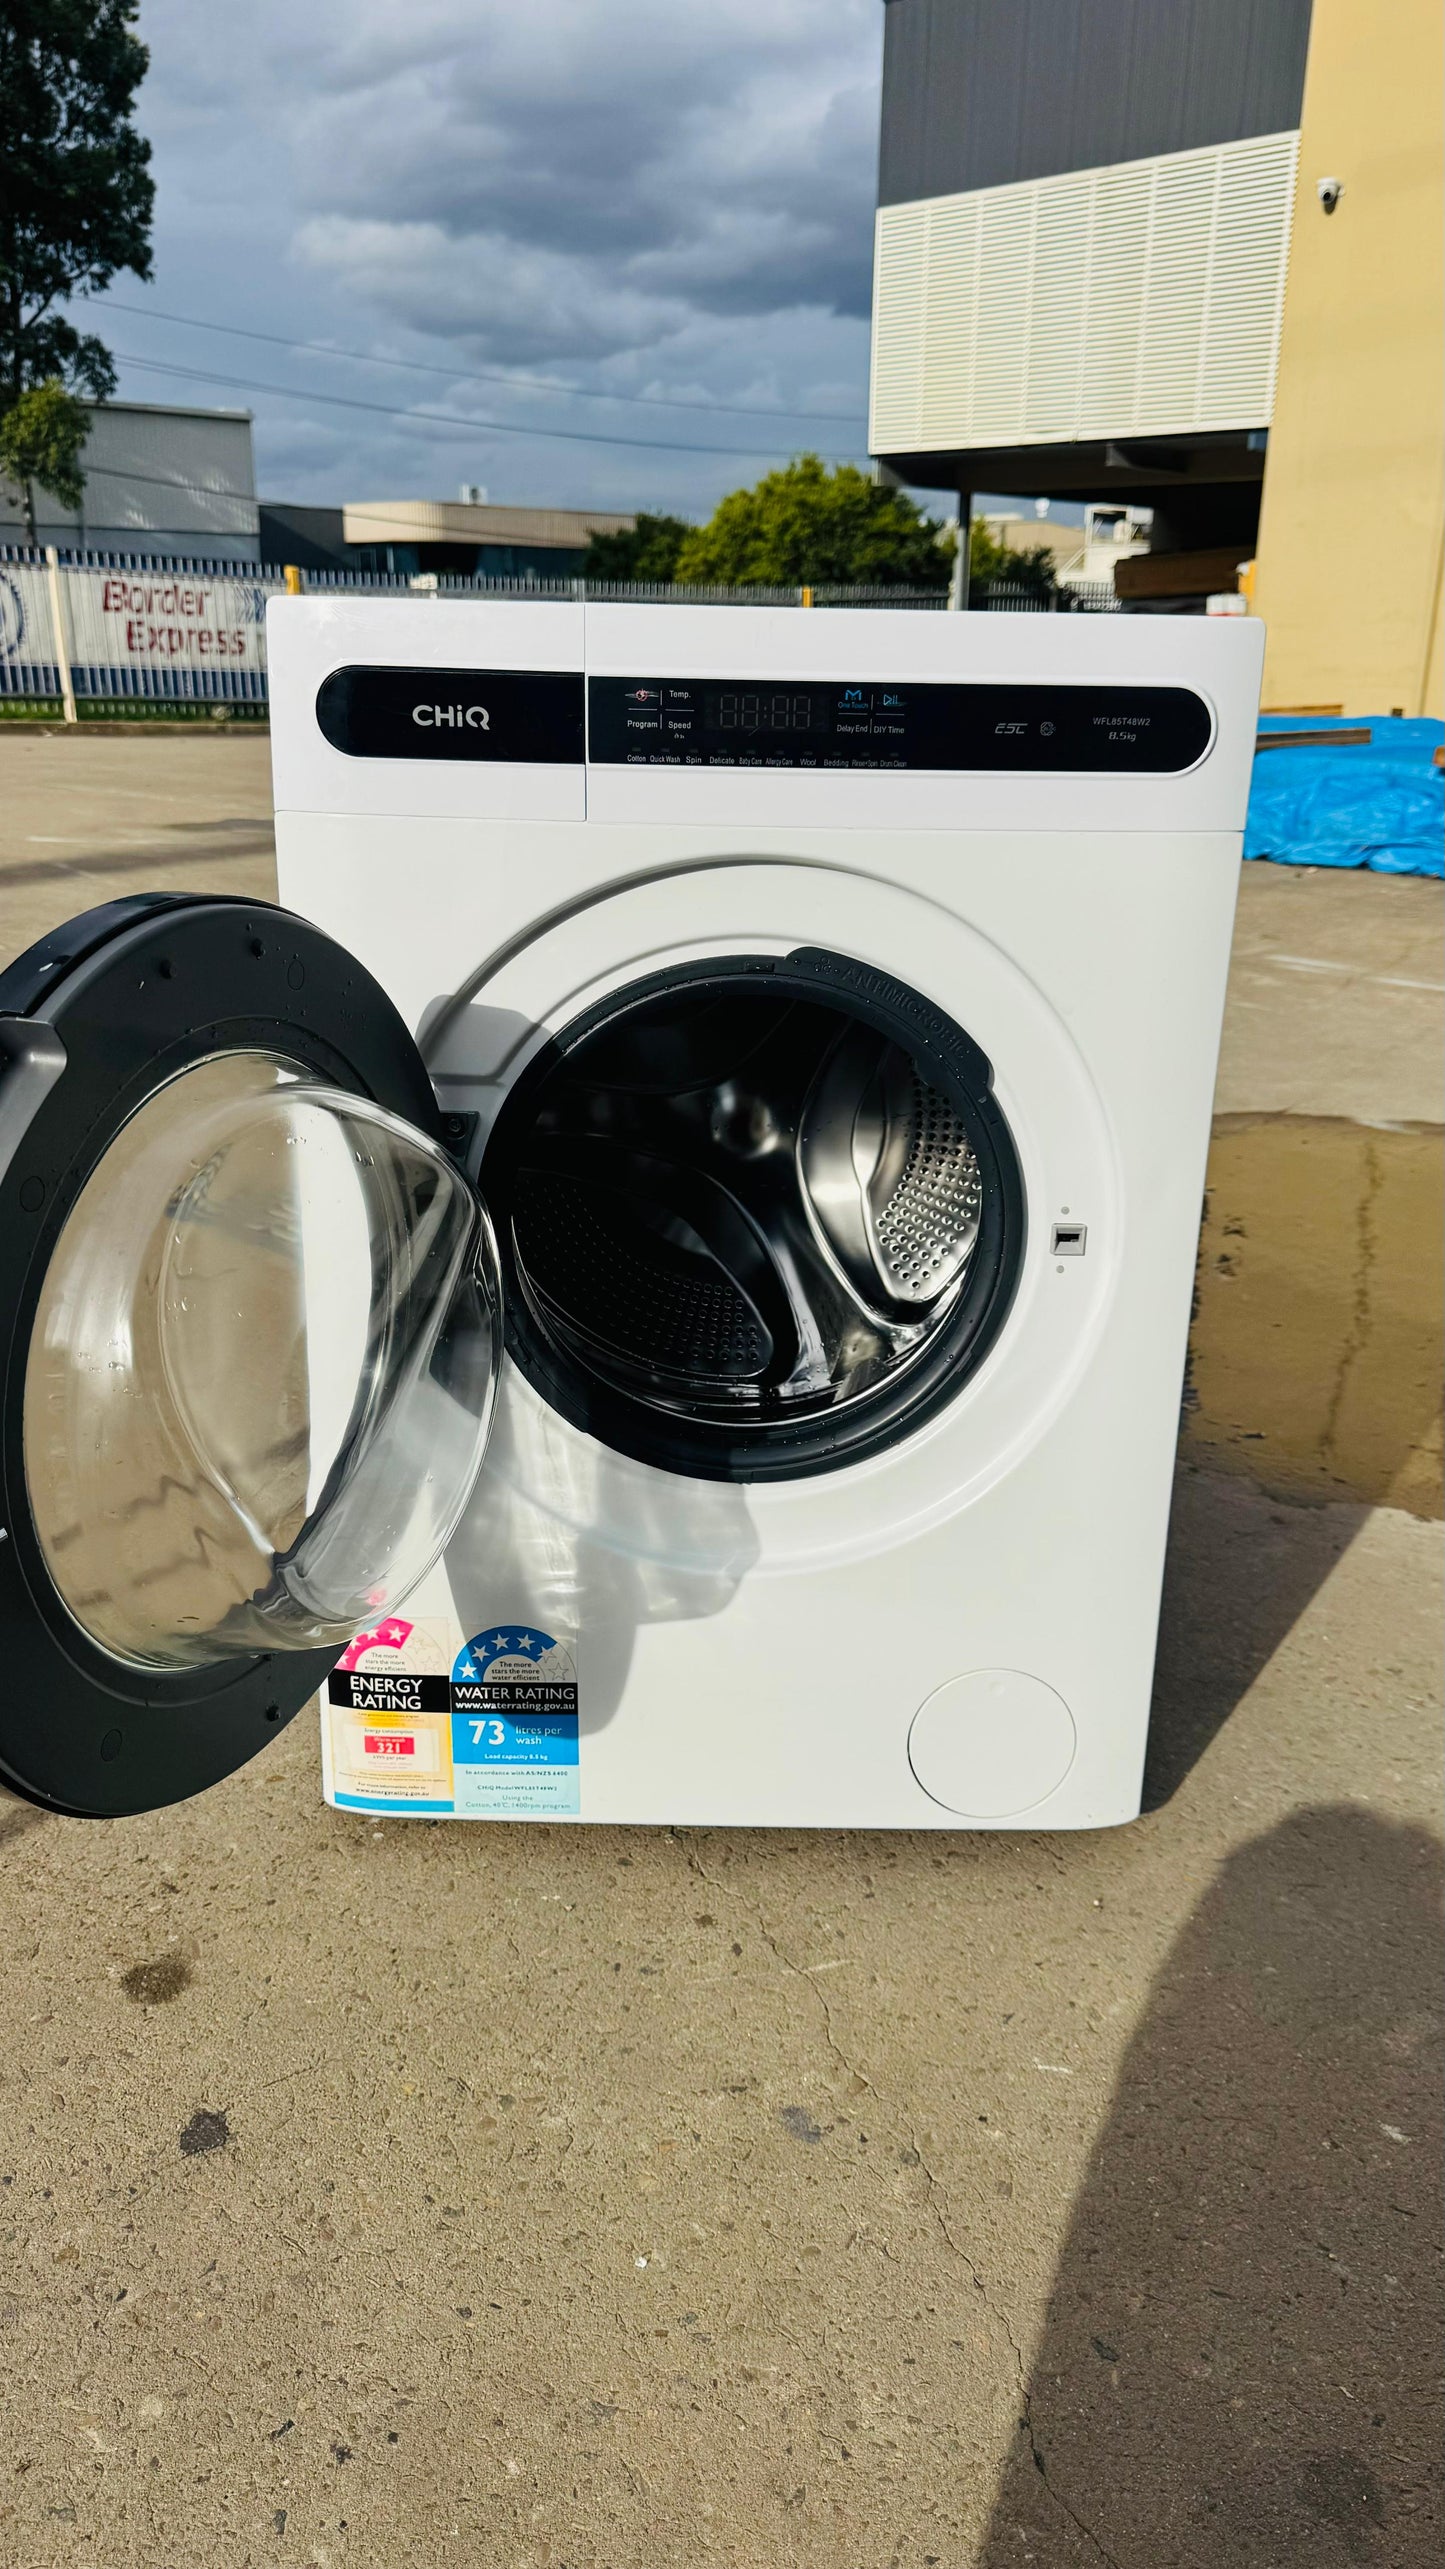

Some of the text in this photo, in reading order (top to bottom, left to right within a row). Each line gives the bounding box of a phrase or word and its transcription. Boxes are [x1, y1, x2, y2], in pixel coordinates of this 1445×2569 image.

[103, 581, 213, 617] Border
[127, 620, 247, 657] Express
[669, 690, 691, 700] Temp.
[627, 720, 658, 730] Program
[668, 721, 692, 730] Speed
[1092, 716, 1151, 727] WFL85T48W2
[836, 724, 868, 734] Delay End
[873, 726, 905, 734] DIY Time
[627, 754, 647, 763] Cotton
[649, 755, 681, 764] Quick Wash
[685, 756, 702, 765] Spin
[709, 756, 735, 765] Delicate
[739, 757, 763, 766] Baby Care
[765, 757, 793, 767] Allergy Care
[800, 758, 817, 766] Wool
[823, 758, 849, 767] Bedding
[350, 1676, 423, 1694] ENERGY
[455, 1686, 575, 1700] WATER RATING
[352, 1692, 422, 1710] RATING
[455, 1702, 575, 1712] www.waterrating.gov.au
[468, 1720, 505, 1745] 73
[515, 1725, 562, 1736] litres per
[515, 1735, 542, 1745] wash
[377, 1743, 401, 1754] 321
